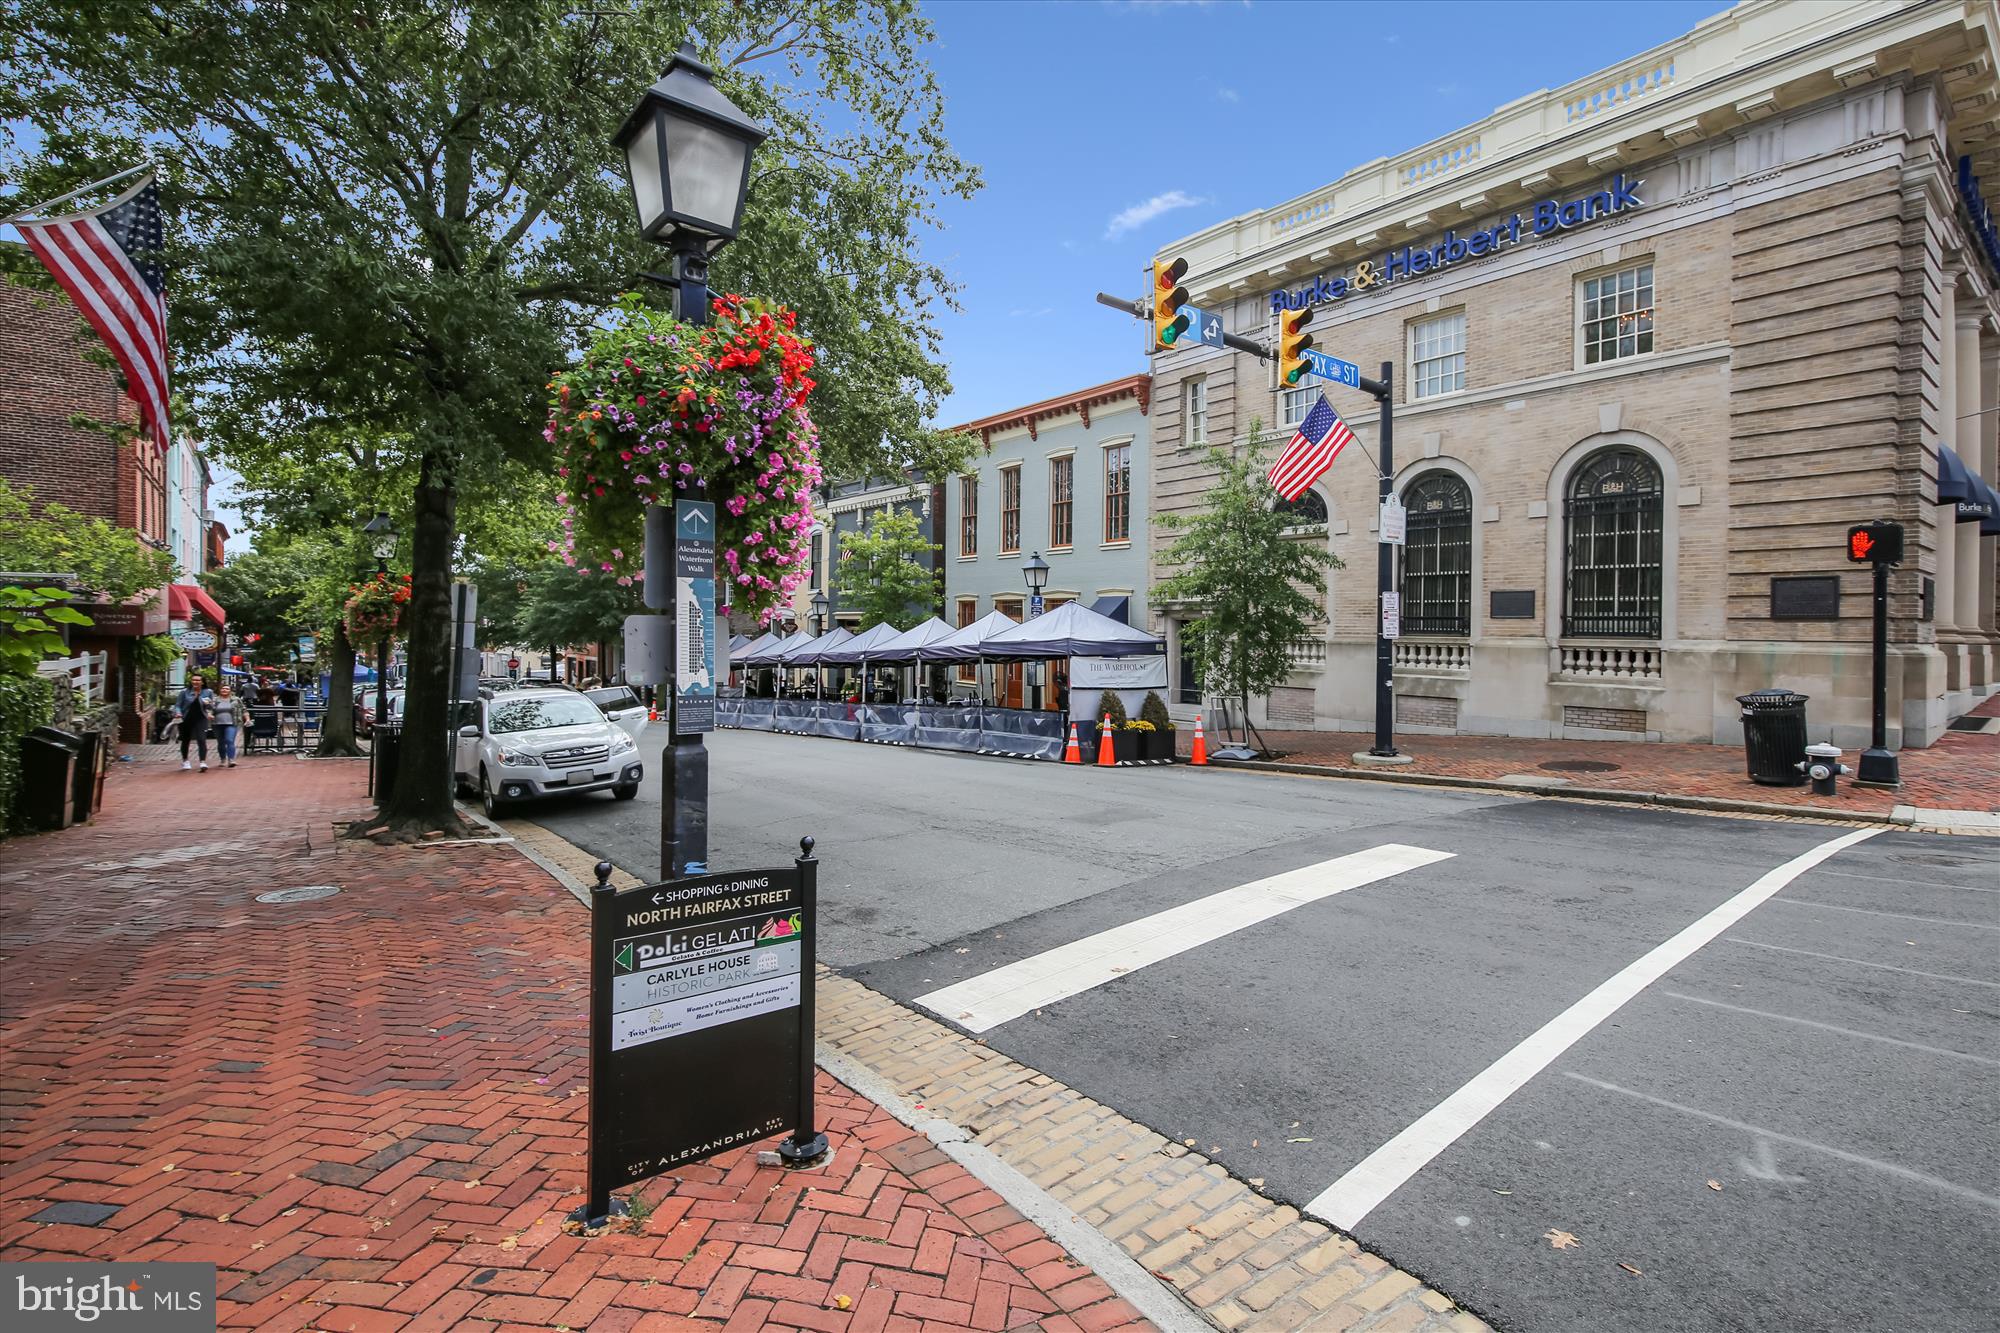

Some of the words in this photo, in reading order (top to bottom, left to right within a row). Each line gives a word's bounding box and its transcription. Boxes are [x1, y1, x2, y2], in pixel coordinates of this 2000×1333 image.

[1270, 275, 1348, 312] Burke
[1353, 260, 1376, 289] &
[1384, 213, 1523, 283] Herbert
[1533, 174, 1642, 237] Bank
[1343, 364, 1356, 385] ST
[1959, 503, 1982, 511] Burke
[678, 545, 714, 554] Alexandria
[678, 554, 713, 564] Waterfront
[687, 565, 705, 573] Walk
[1090, 663, 1104, 672] THE
[1104, 663, 1148, 672] WAREHOUSE
[666, 884, 723, 902] SHOPPING
[731, 877, 769, 892] DINING
[627, 906, 681, 927] NORTH
[684, 897, 741, 917] FAIRFAX
[744, 889, 792, 907] STREET
[636, 934, 687, 960] Dolci
[692, 925, 756, 950] GELATI
[671, 951, 695, 961] Gelato
[700, 947, 723, 956] Coffee
[647, 965, 705, 985] CARLYLE
[708, 955, 750, 973] HOUSE
[647, 976, 713, 1000] HISTORIC
[718, 969, 750, 985] PARK
[686, 1001, 713, 1013] Women's
[714, 996, 741, 1008] Clothing
[742, 992, 754, 1000] and
[754, 985, 789, 997] Accessories
[696, 1010, 714, 1020] Home
[715, 1003, 752, 1015] Furnishings
[753, 998, 765, 1006] and
[765, 995, 780, 1004] Gifts
[627, 1028, 649, 1038] Twist
[649, 1020, 683, 1033] Boutique
[766, 1117, 783, 1126] EST.
[766, 1122, 783, 1131] 1749
[658, 1127, 761, 1166] ALEXANDRIA
[627, 1160, 650, 1171] CITY
[631, 1168, 644, 1176] OF
